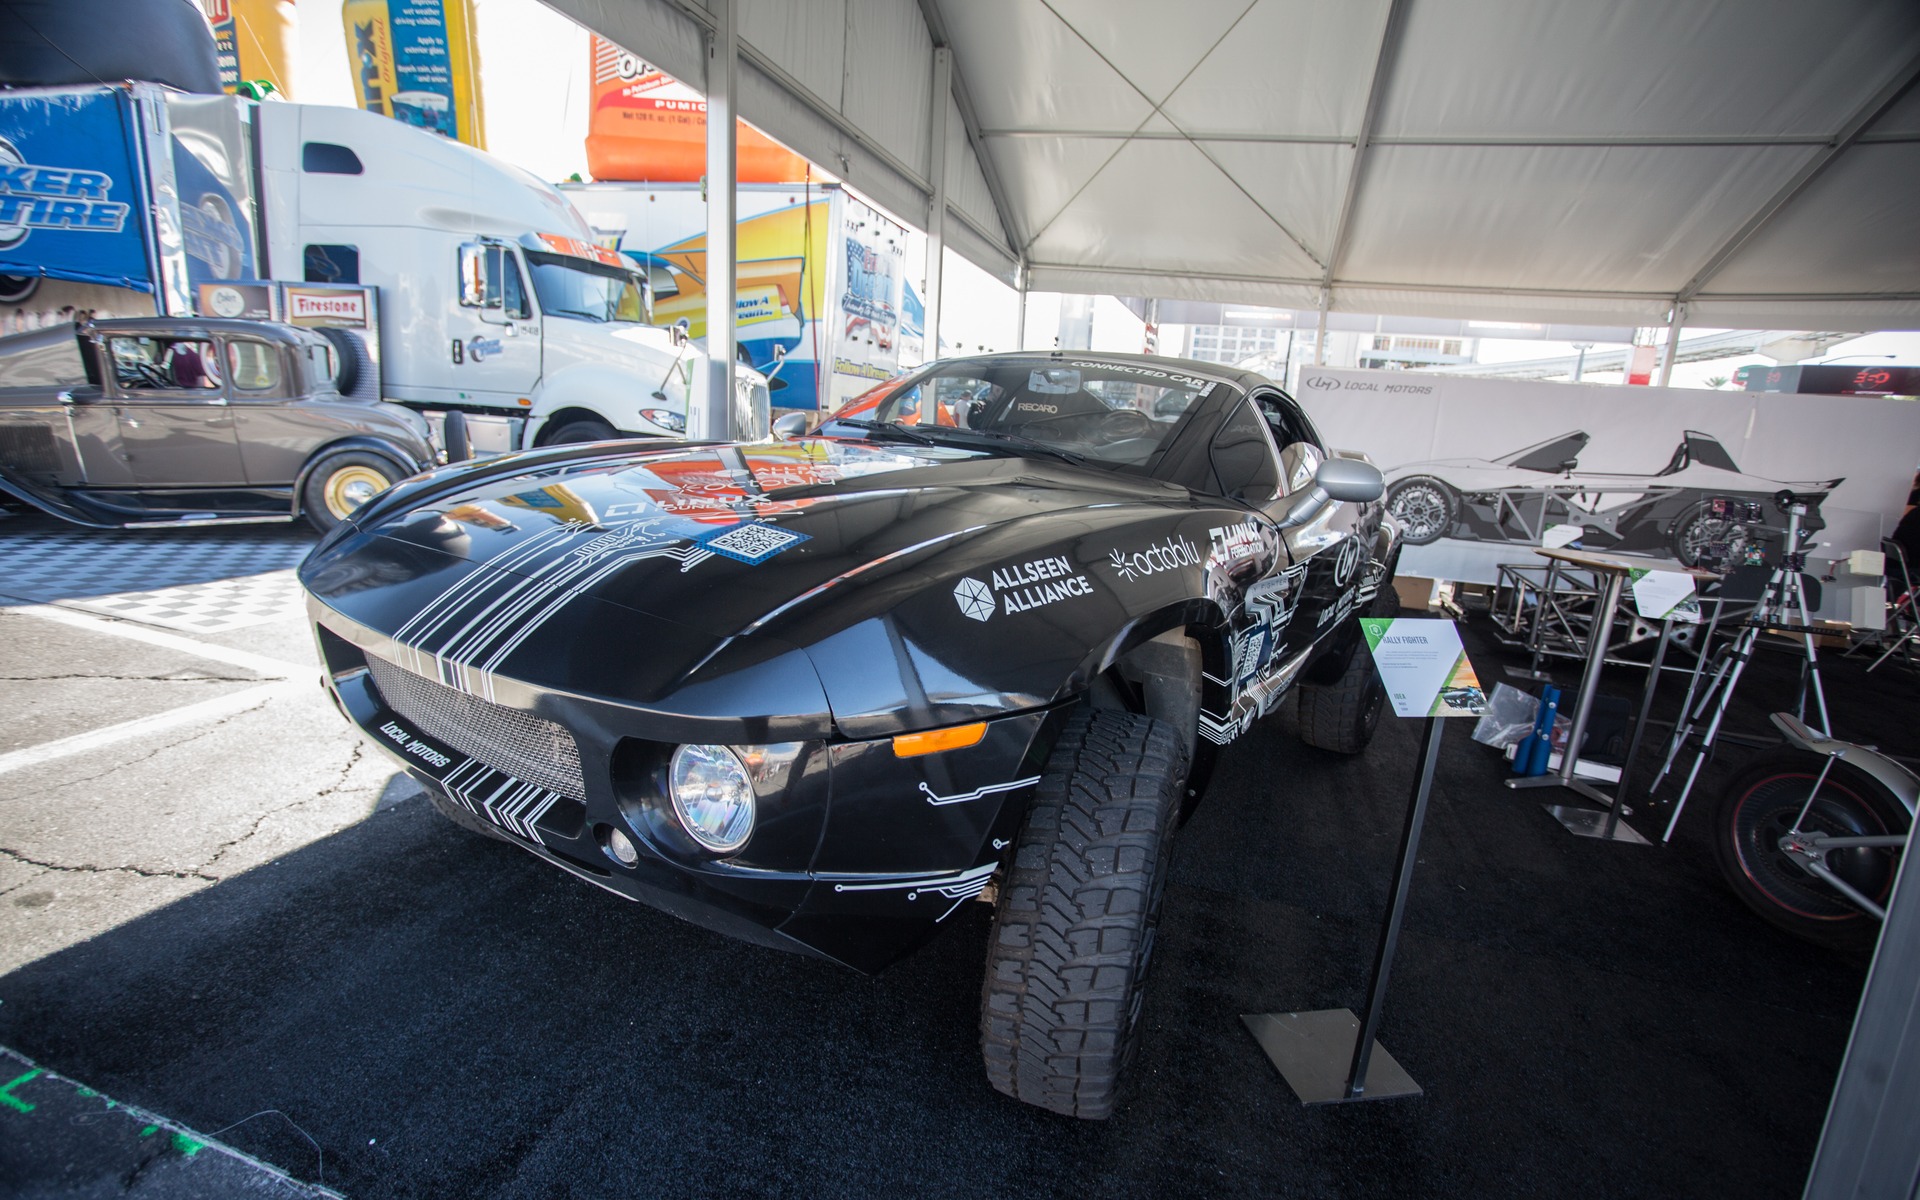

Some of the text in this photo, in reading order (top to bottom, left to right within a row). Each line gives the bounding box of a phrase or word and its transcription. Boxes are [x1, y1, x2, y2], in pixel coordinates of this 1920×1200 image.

[297, 297, 357, 314] Firestone
[1070, 360, 1168, 379] CONNECTED
[1169, 373, 1205, 388] CAR
[1344, 380, 1379, 392] LOCAL
[1383, 383, 1433, 396] MOTORS
[1017, 402, 1058, 415] RECARO
[1225, 521, 1262, 545] LINUX
[1133, 534, 1202, 576] octoblu
[992, 555, 1074, 592] ALLSEEN
[1003, 575, 1094, 616] ALLIANCE
[1383, 636, 1429, 645] RALLY FIGHTER
[379, 720, 451, 768] LOCAL MOTORS
